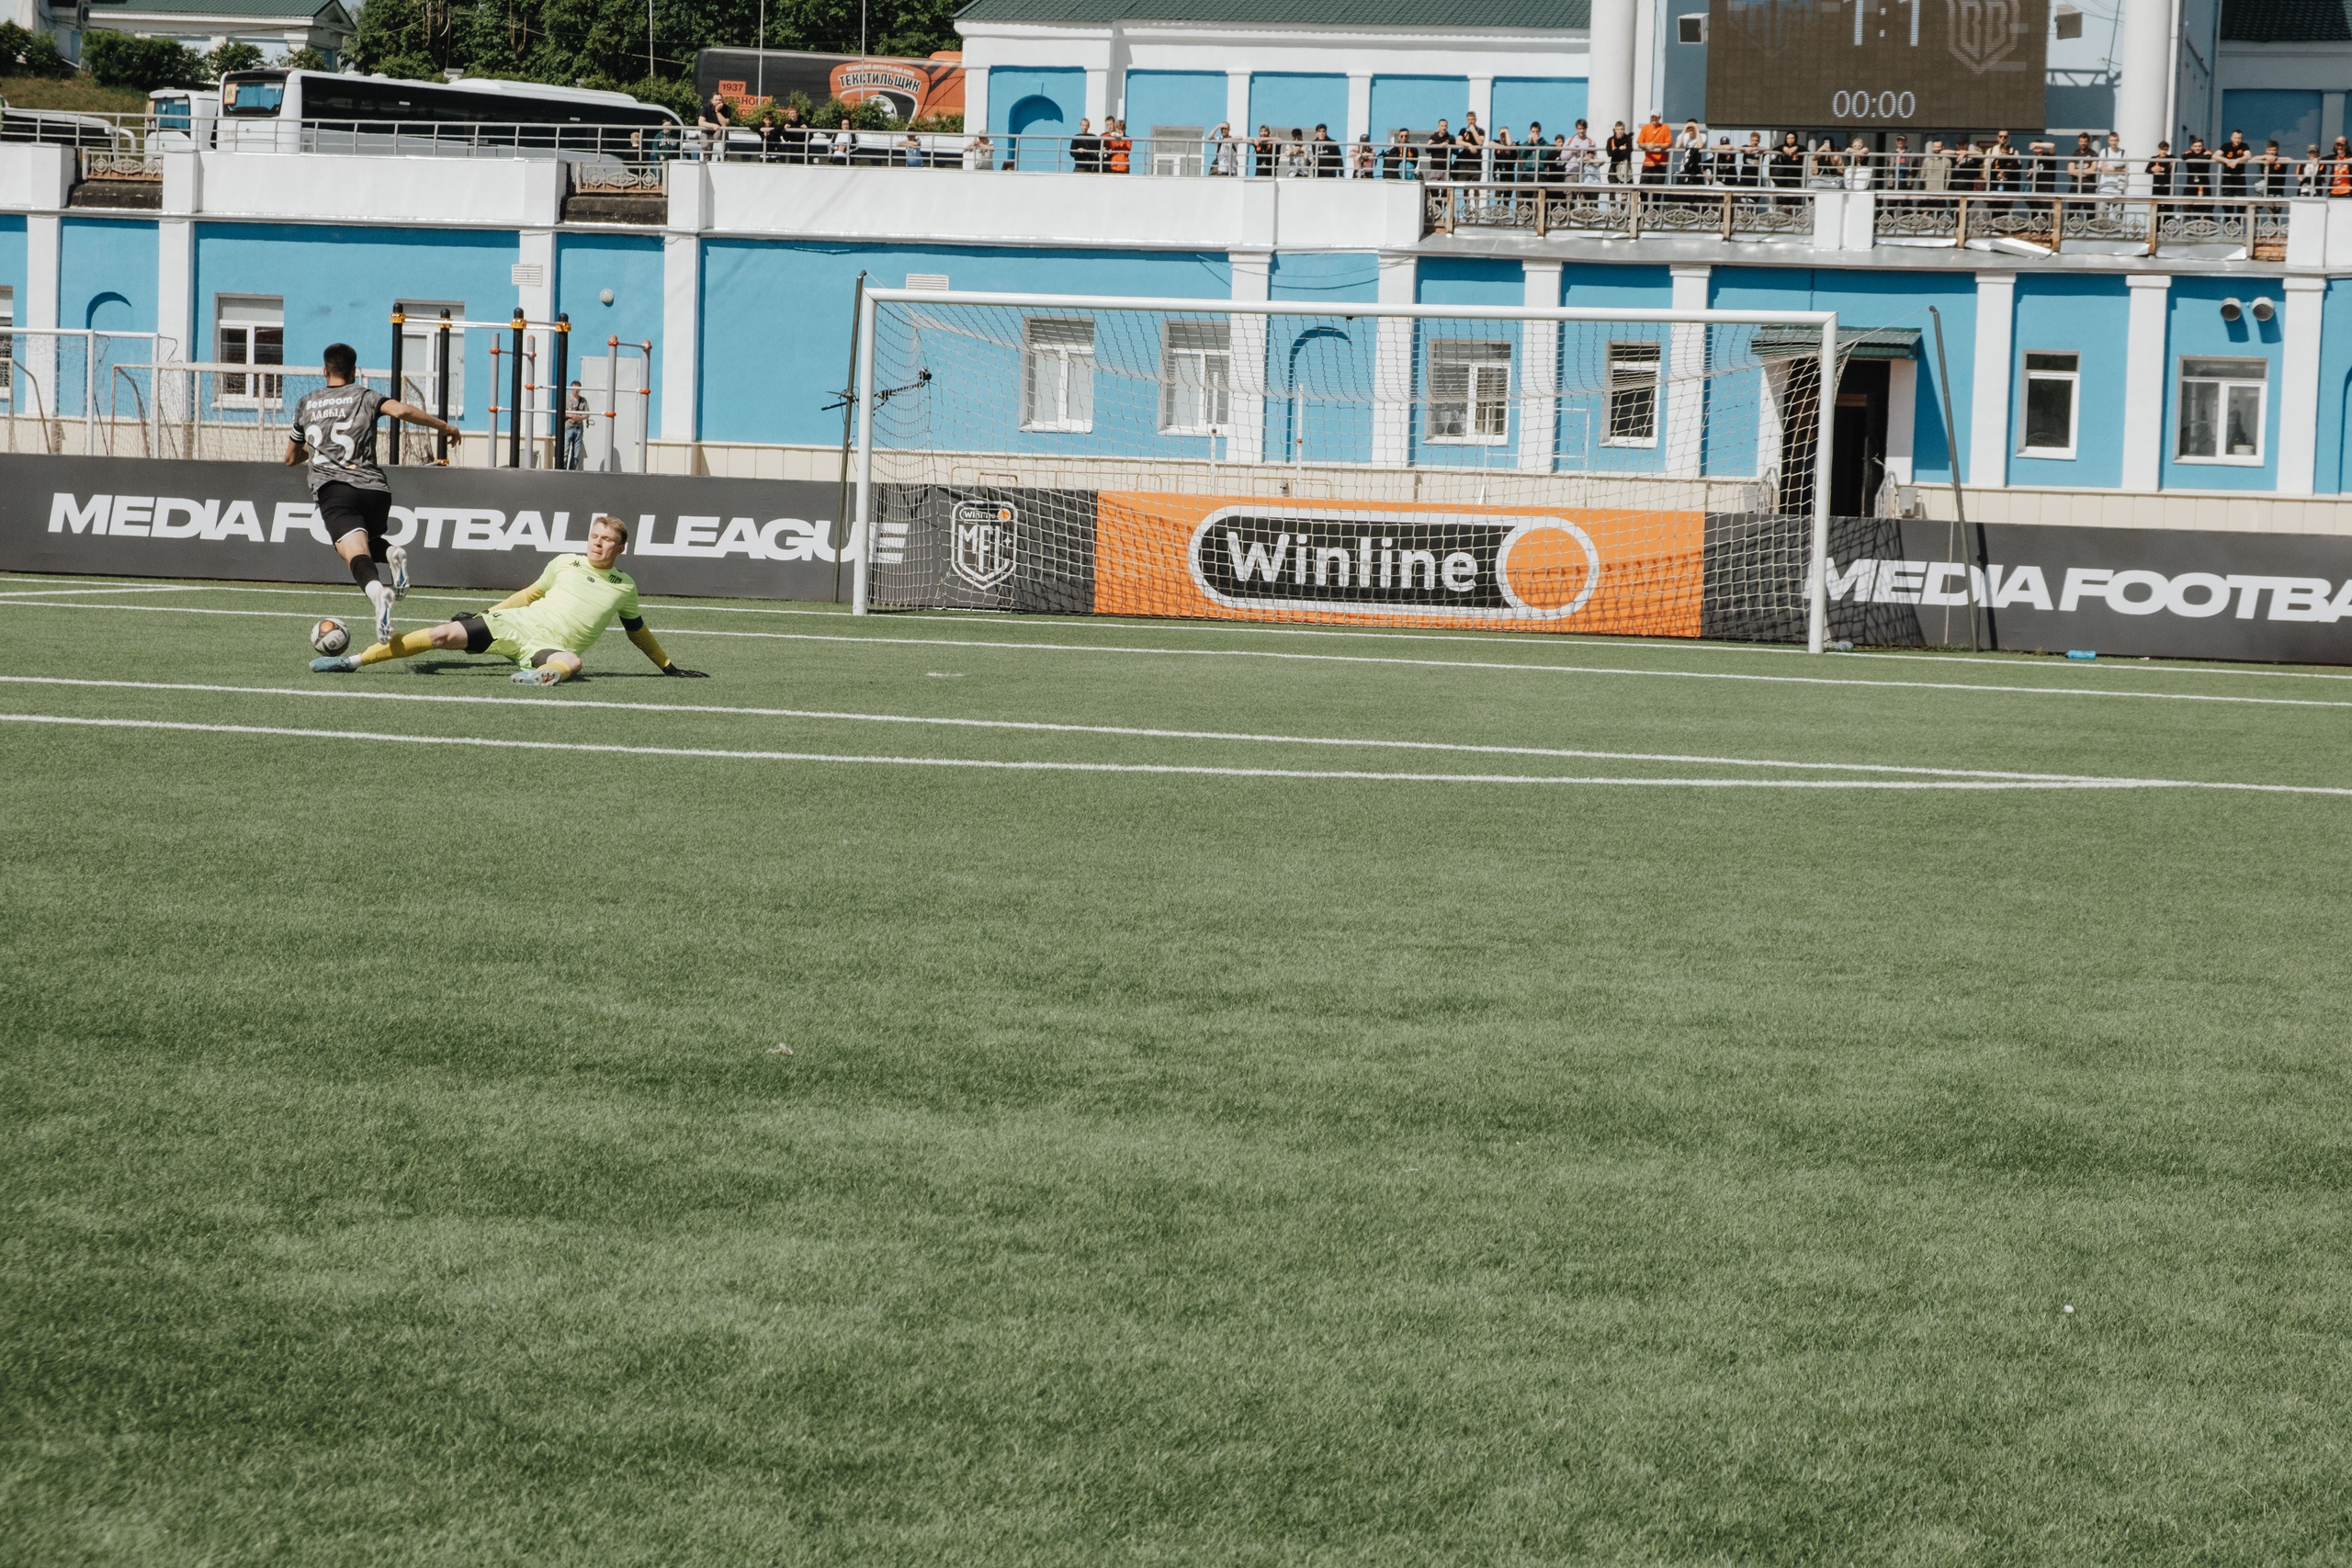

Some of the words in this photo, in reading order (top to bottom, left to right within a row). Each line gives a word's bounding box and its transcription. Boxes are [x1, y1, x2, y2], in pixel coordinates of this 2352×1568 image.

[721, 83, 744, 92] 1937
[838, 72, 922, 93] ТЕКСТИЛЬЩИК
[1832, 91, 1916, 118] 00:00
[311, 407, 346, 423] ДАВЫД
[305, 419, 356, 466] 25
[47, 492, 265, 542] MEDIA
[269, 502, 629, 556] FOTBAL
[634, 514, 909, 564] LEAGUE
[1227, 531, 1478, 592] Winline
[1803, 557, 2054, 611] MEDIA
